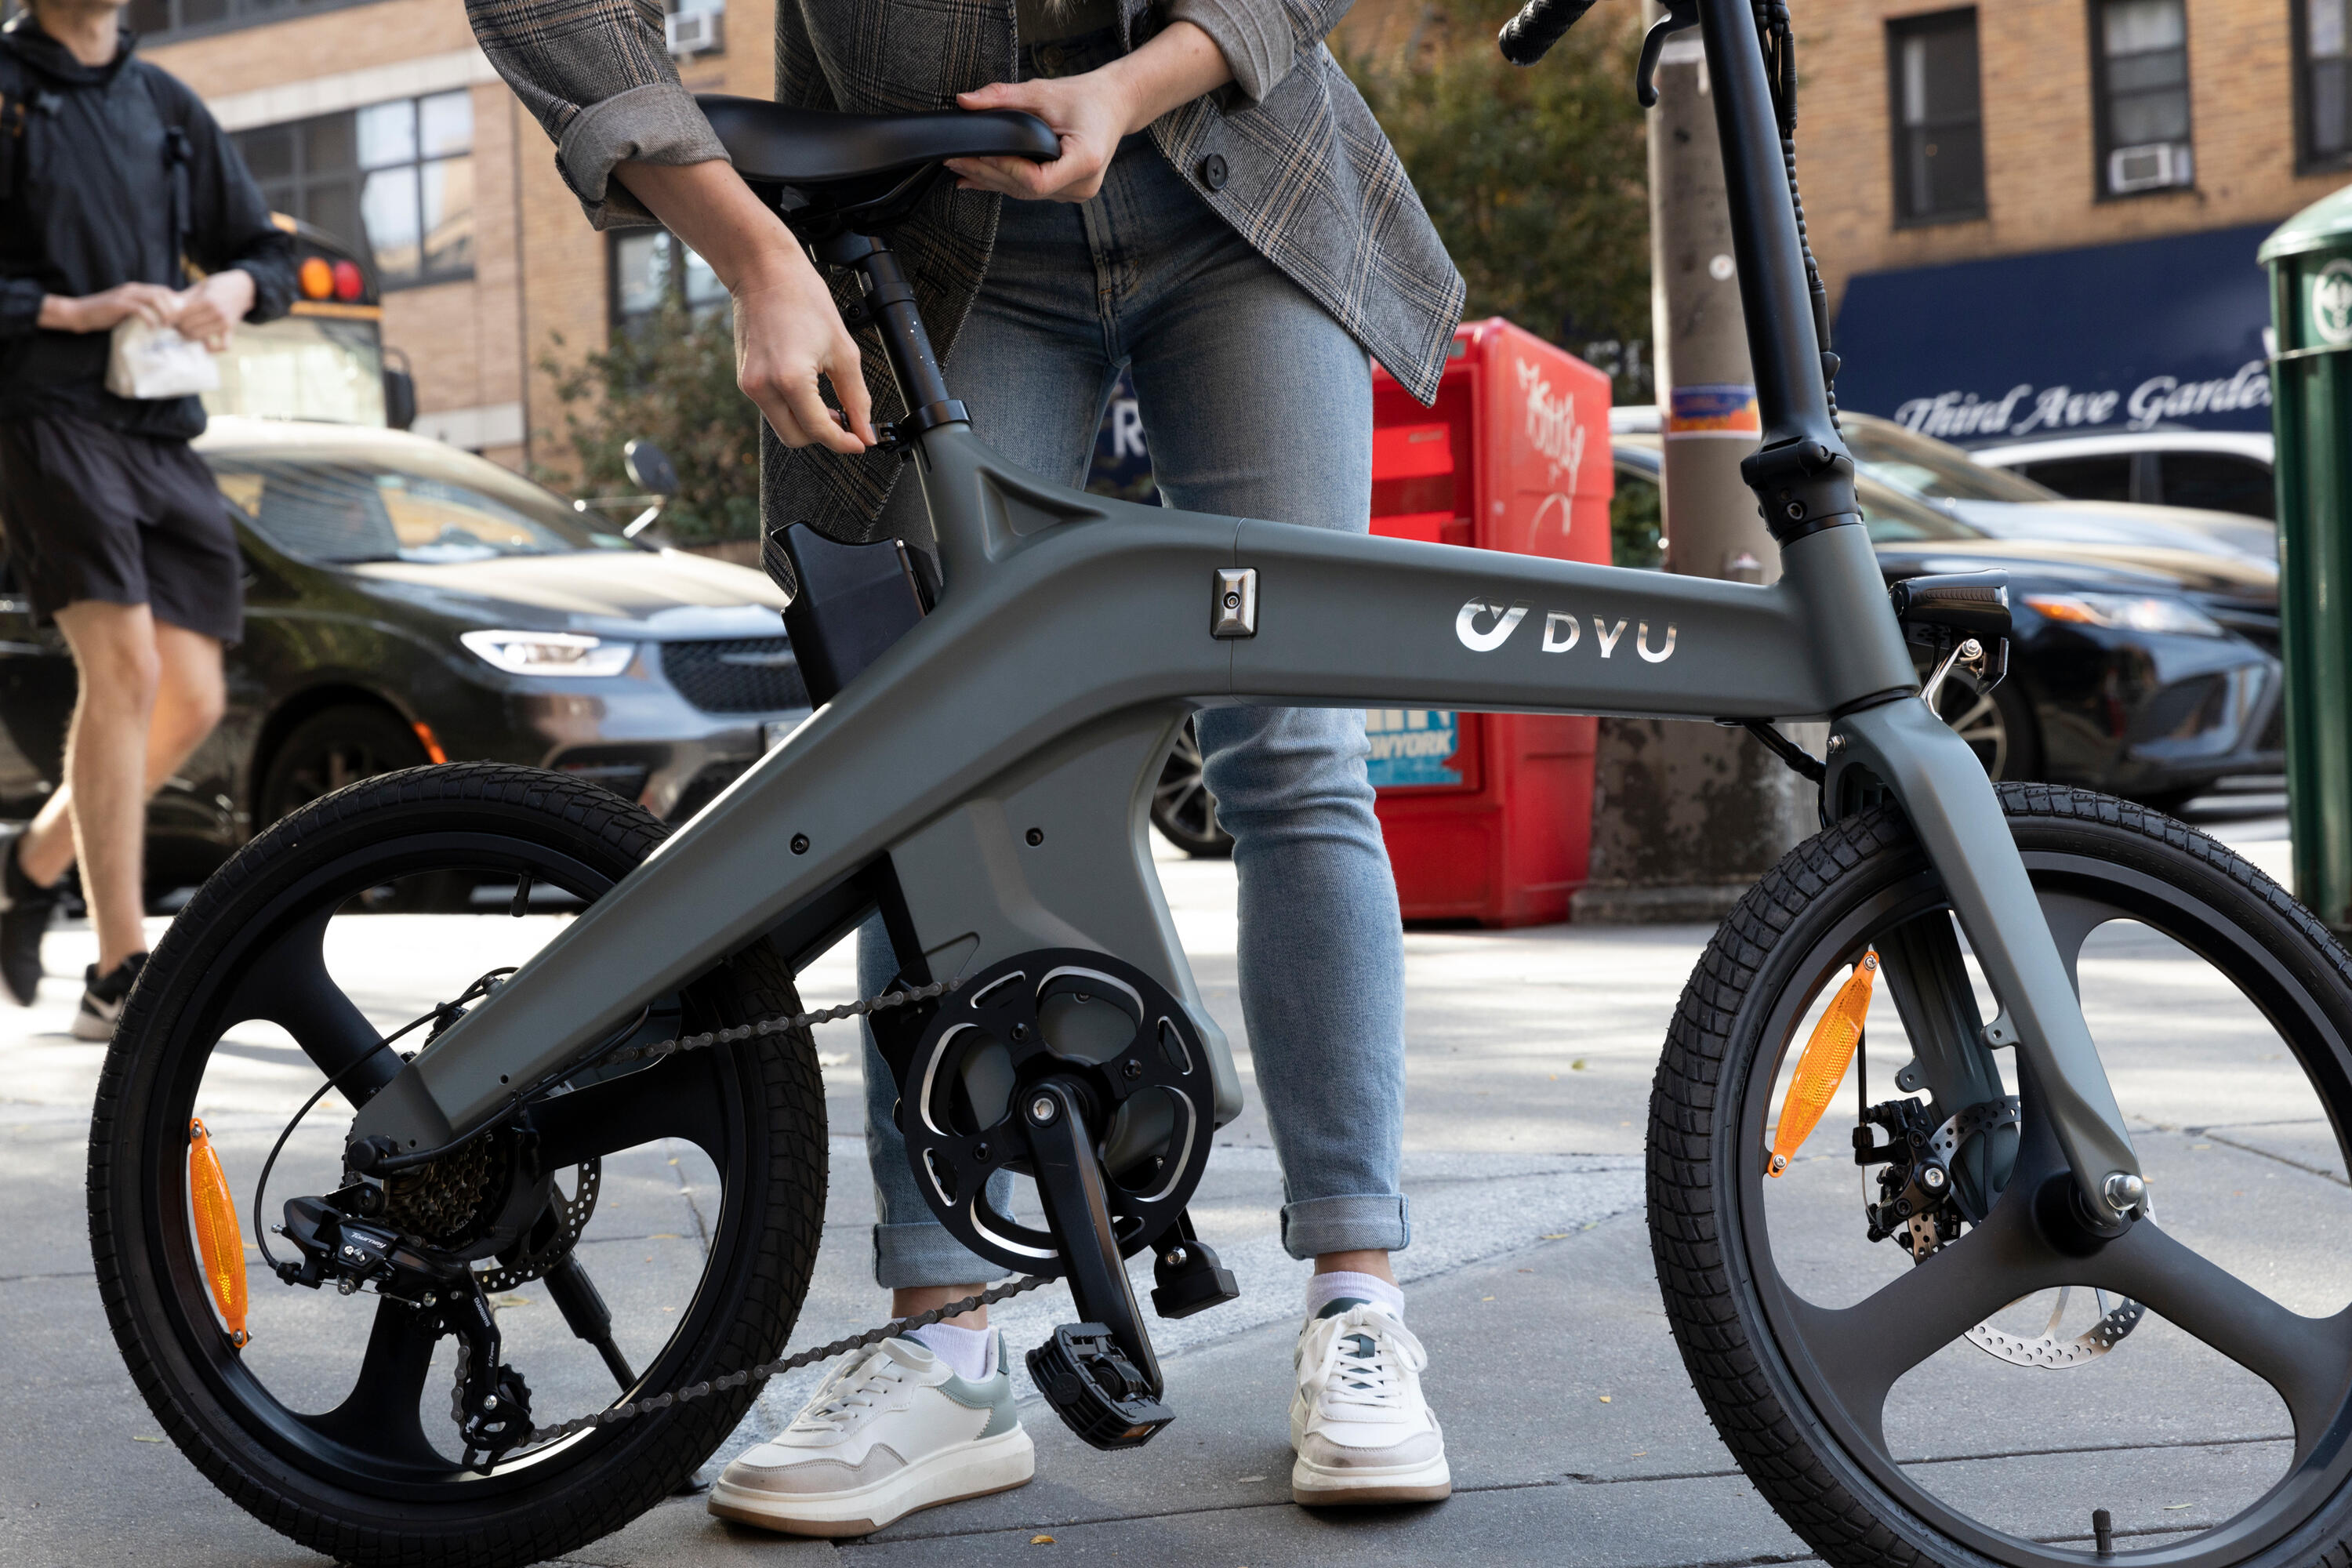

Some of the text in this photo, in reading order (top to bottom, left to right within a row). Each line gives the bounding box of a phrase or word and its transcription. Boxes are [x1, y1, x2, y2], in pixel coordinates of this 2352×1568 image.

[1894, 360, 2272, 437] Third Ave Garde
[1542, 609, 1678, 663] DYU
[351, 1232, 387, 1249] Tourney
[474, 1297, 492, 1328] SHIMANO
